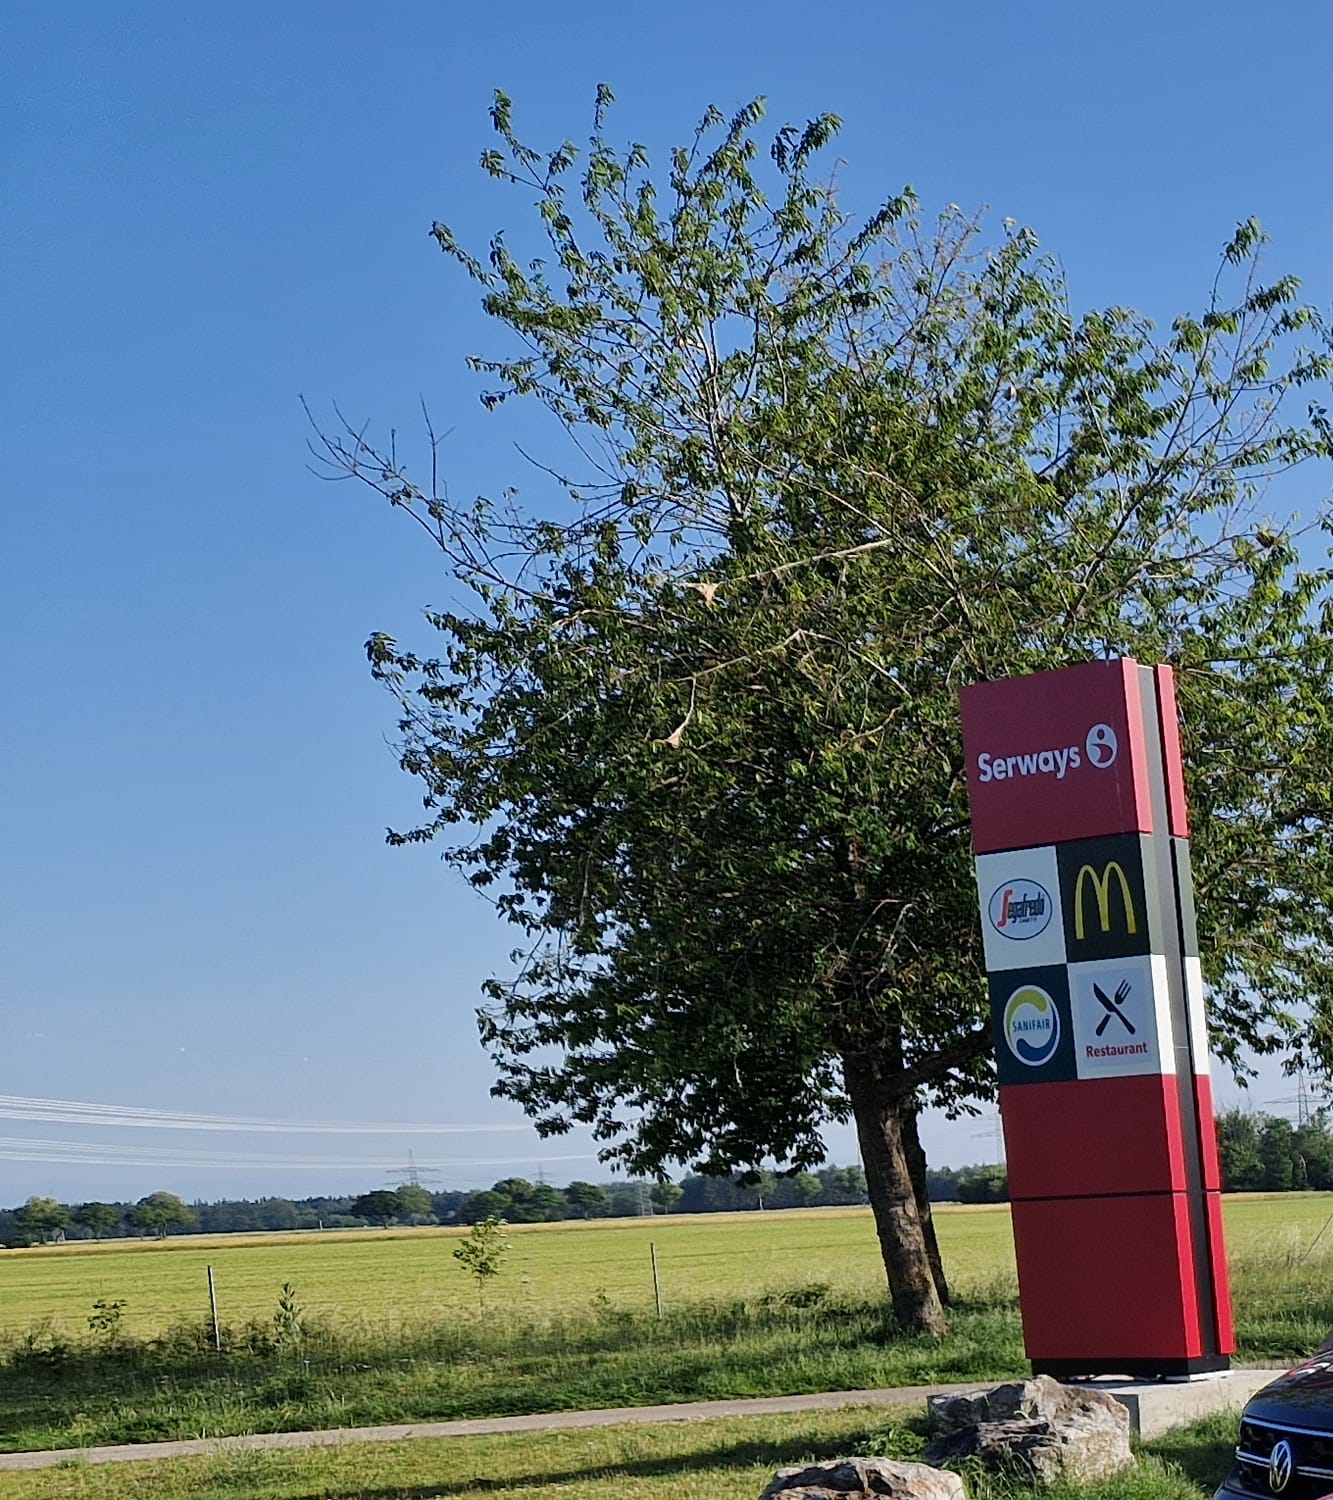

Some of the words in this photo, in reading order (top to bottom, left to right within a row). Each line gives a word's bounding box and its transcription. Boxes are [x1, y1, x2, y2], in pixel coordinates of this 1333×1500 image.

[978, 746, 1081, 782] Serways
[1012, 1018, 1052, 1033] SANIFAIR
[1085, 1042, 1149, 1058] Restaurant
